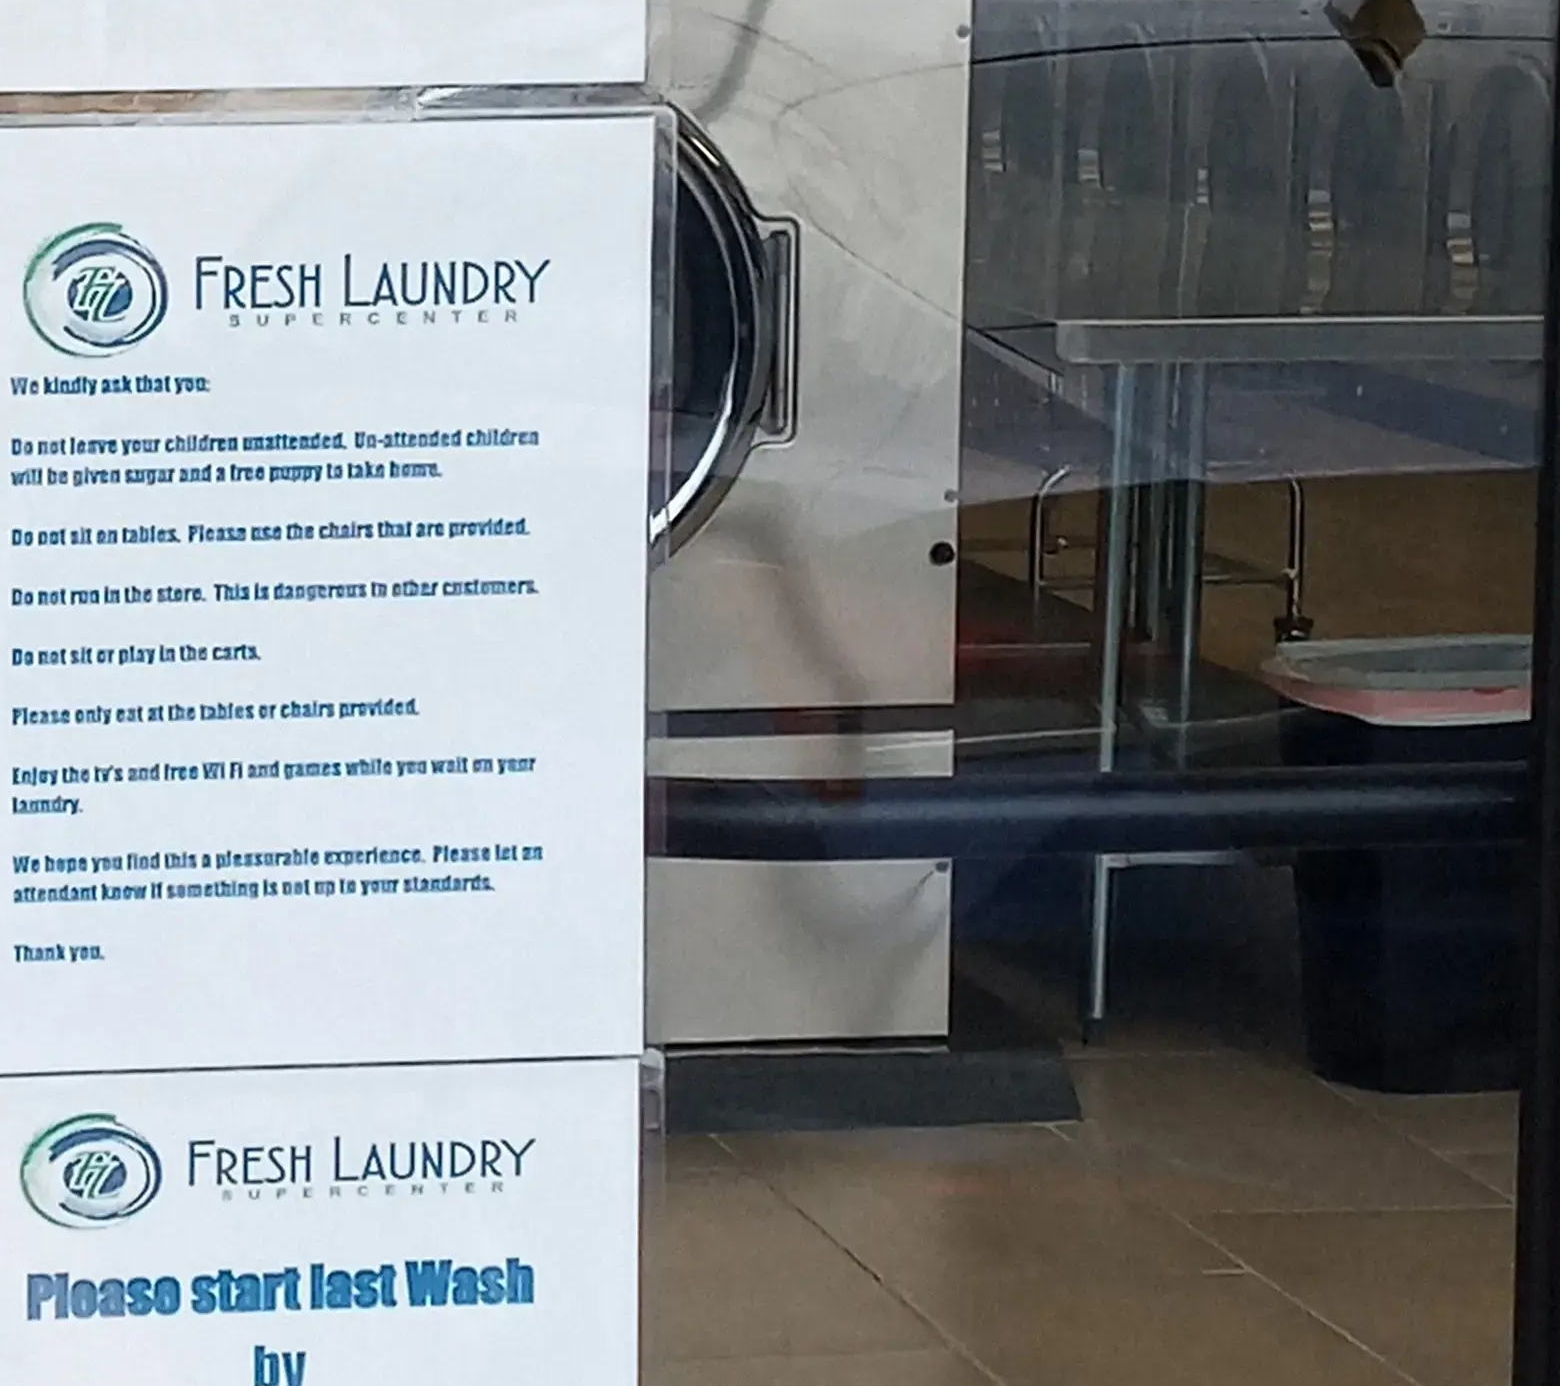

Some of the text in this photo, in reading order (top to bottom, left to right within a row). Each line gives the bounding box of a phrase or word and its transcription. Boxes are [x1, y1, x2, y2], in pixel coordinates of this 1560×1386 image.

[196, 254, 550, 310] FRESH LAUNDRY
[230, 309, 516, 328] SUPERCENTER
[10, 376, 39, 396] We
[43, 375, 98, 397] kindly
[100, 374, 133, 395] ask
[135, 374, 171, 394] that
[11, 437, 34, 457] Do
[37, 437, 67, 457] not
[69, 436, 118, 457] leave
[121, 437, 161, 457] your
[164, 433, 239, 454] children
[465, 428, 539, 448] children
[10, 460, 385, 488] will be given sugar and a free puppy to take
[11, 527, 34, 548] Do
[37, 527, 66, 547] not
[70, 527, 93, 546] sit
[96, 528, 118, 545] on
[187, 524, 247, 544] Please
[250, 524, 283, 543] use
[285, 522, 315, 541] the
[318, 521, 374, 540] chairs
[377, 519, 413, 539] that
[415, 521, 445, 539] are
[11, 581, 367, 607] Do not run in the store. This is dangerous
[11, 646, 34, 667] Do
[37, 648, 67, 666] not
[69, 645, 93, 666] sit
[96, 648, 115, 665] or
[118, 645, 156, 667] play
[158, 643, 176, 663] in
[179, 644, 208, 663] the
[11, 706, 71, 727] Please
[74, 704, 112, 726] only
[115, 705, 144, 724] eat
[147, 704, 164, 723] at
[167, 703, 196, 723] the
[199, 701, 255, 722] tables
[258, 703, 277, 720] or
[279, 699, 335, 720] chairs
[12, 766, 59, 788] Enjoy
[61, 765, 90, 785] the
[127, 762, 161, 783] and
[163, 762, 199, 782] free
[247, 759, 280, 780] and
[283, 761, 342, 781] games
[344, 757, 393, 778] while
[395, 759, 428, 778] you
[430, 755, 469, 775] wait
[497, 756, 537, 776] your
[12, 854, 41, 875] We
[44, 853, 88, 875] hope
[90, 855, 123, 874] you
[126, 851, 161, 872] find
[164, 850, 198, 871] this
[215, 847, 320, 871] pleasurable
[432, 844, 491, 864] Please
[494, 843, 518, 863] let
[13, 883, 98, 904] attendant
[100, 882, 148, 901] know
[150, 880, 163, 901] if
[166, 879, 260, 900] something
[262, 878, 279, 897] is
[281, 878, 311, 897] not
[339, 878, 357, 895] to
[360, 878, 400, 897] your
[13, 942, 105, 964] Thank you.
[189, 1136, 535, 1188] FRESH LAUNDRY
[223, 1181, 503, 1201] SUPERCENTER
[28, 1257, 534, 1320] Please start last Wash
